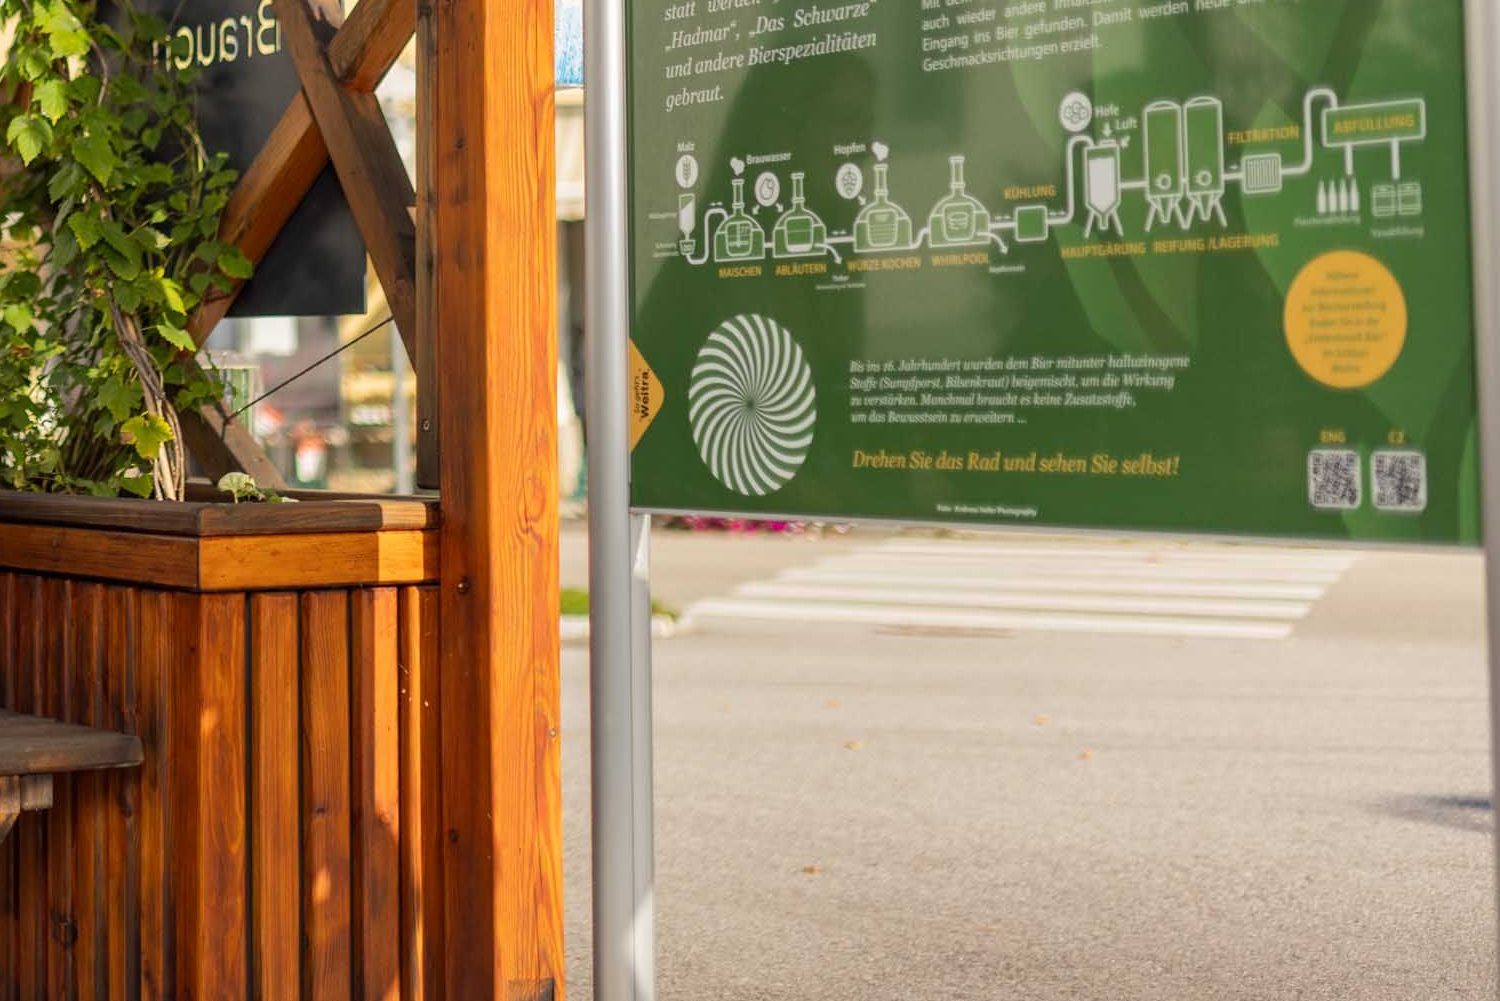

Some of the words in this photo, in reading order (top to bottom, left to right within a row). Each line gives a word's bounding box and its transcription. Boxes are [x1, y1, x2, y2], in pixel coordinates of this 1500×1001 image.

[663, 0, 696, 21] statt
[664, 56, 693, 79] und
[694, 51, 745, 74] andere
[746, 30, 876, 66] Bierspezialitäten
[664, 84, 724, 112] gebraut.
[851, 448, 906, 468] Drehen
[907, 450, 933, 469] Sie
[934, 450, 964, 470] das
[966, 450, 1001, 472] Rad
[1002, 451, 1037, 472] und
[1037, 451, 1088, 473] sehen
[1089, 452, 1118, 474] Sie
[1119, 452, 1180, 476] selbst!
